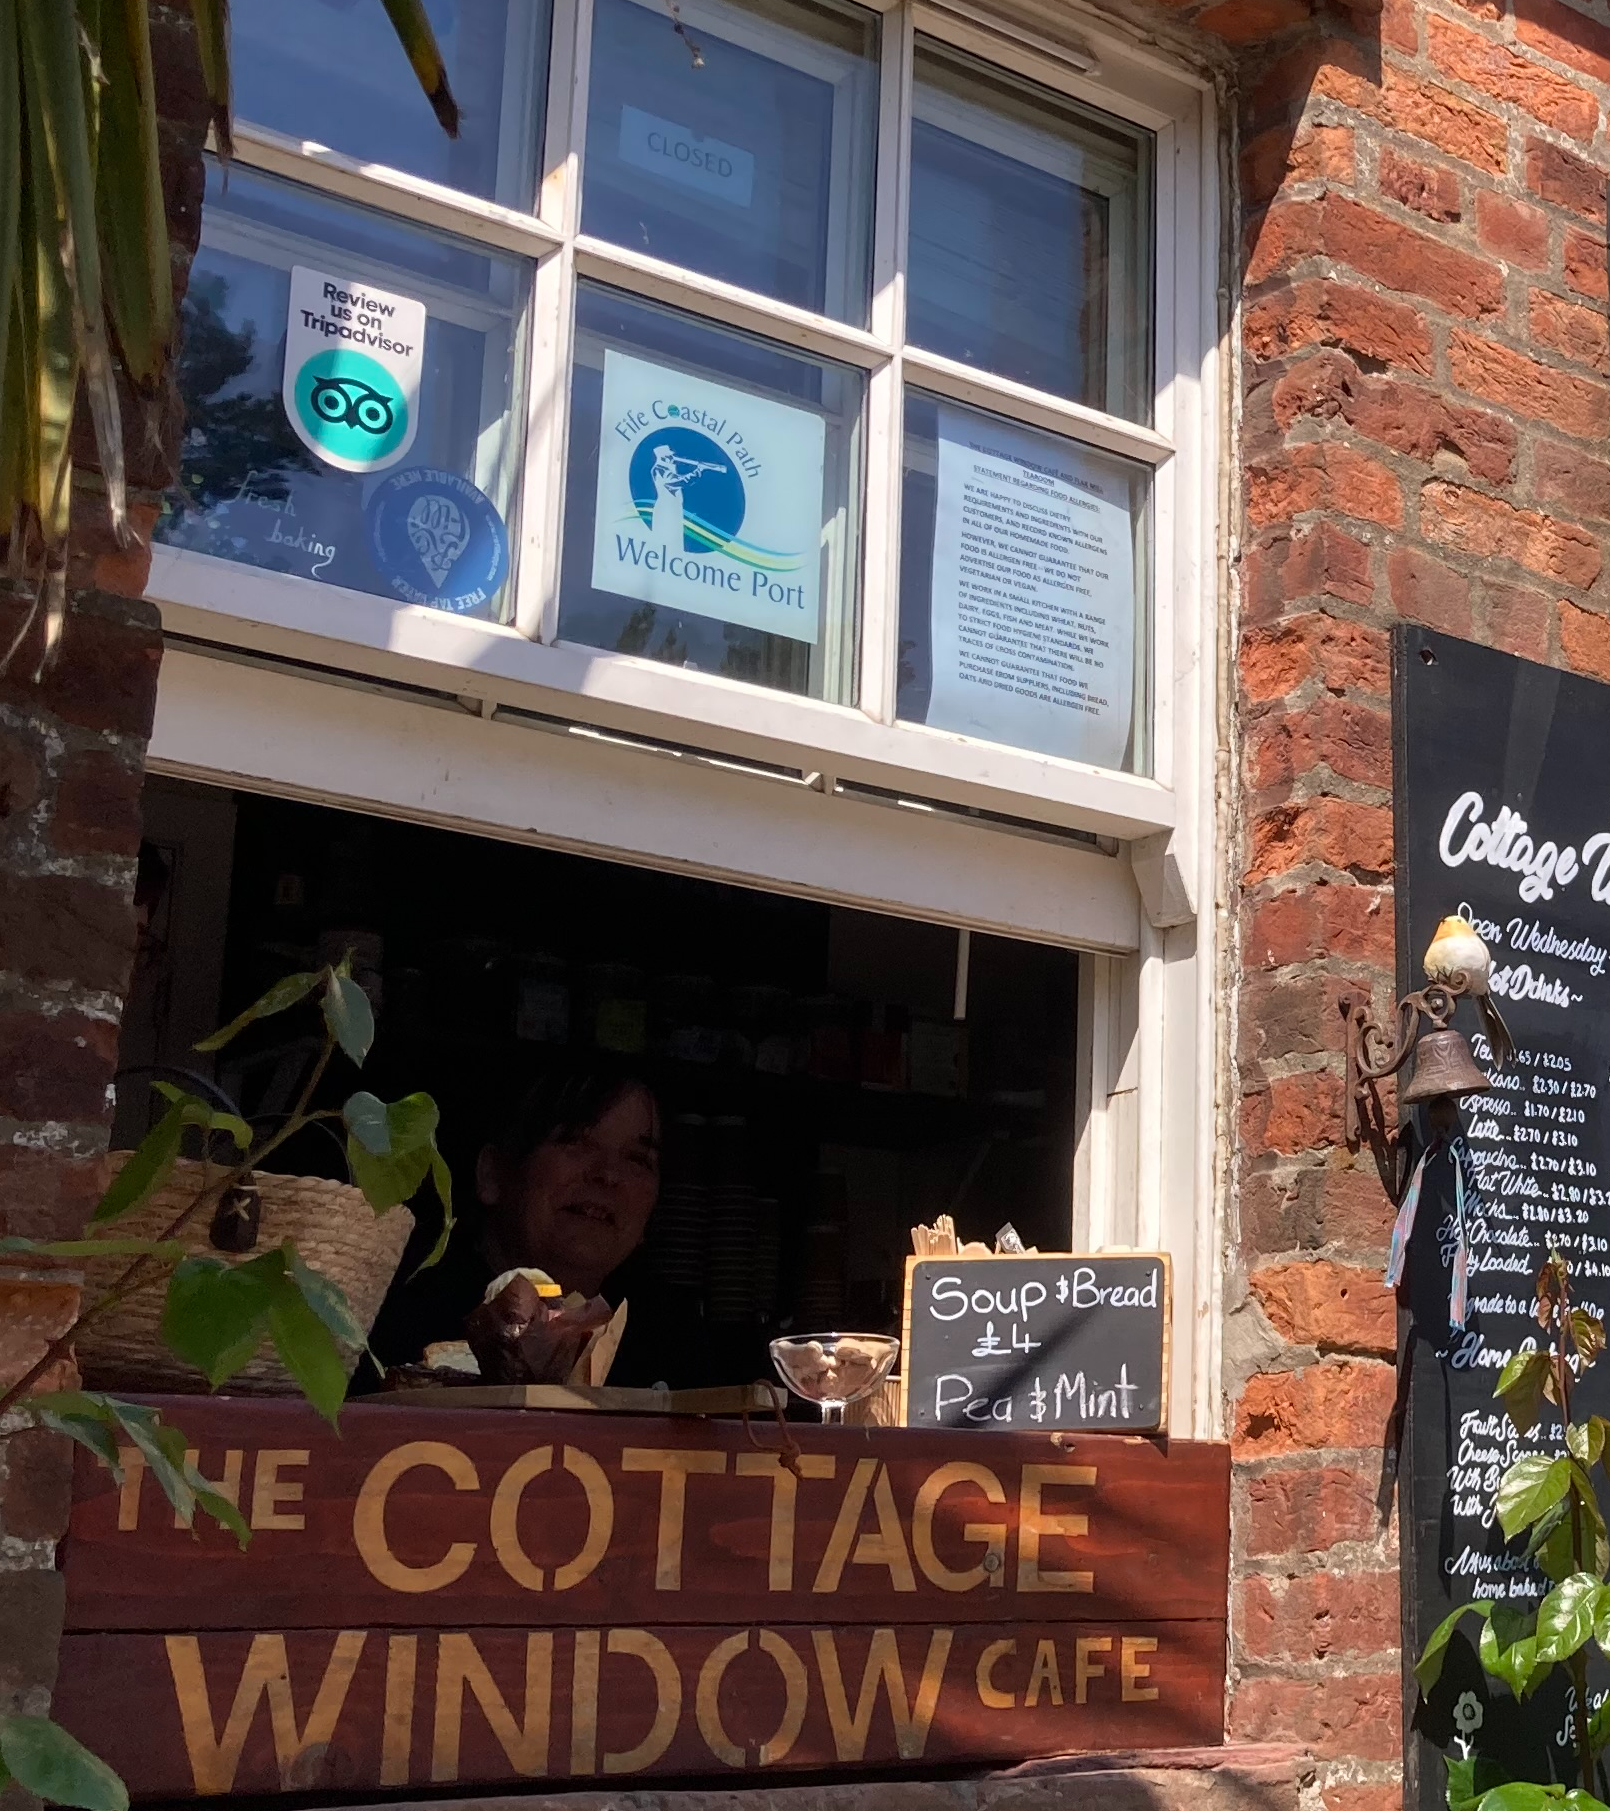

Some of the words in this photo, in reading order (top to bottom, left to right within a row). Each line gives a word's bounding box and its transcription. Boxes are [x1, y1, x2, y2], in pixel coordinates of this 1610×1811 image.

[647, 131, 733, 178] CLOSED
[322, 281, 396, 318] Review
[330, 303, 353, 322] us
[356, 313, 382, 331] on
[300, 309, 414, 357] Tripadvisor
[614, 408, 650, 442] Fife
[651, 400, 727, 437] Coastal
[725, 431, 763, 479] Path
[220, 470, 297, 517] fresh
[263, 517, 337, 580] baking
[615, 533, 742, 592] Welcome
[752, 570, 806, 610] Port
[1439, 791, 1579, 904] Cottage
[1506, 917, 1608, 977] Wednesday
[1467, 1164, 1496, 1193] Flat
[1478, 1246, 1534, 1276] Loaded
[930, 1275, 1048, 1322] Soup
[1071, 1266, 1159, 1310] Bread
[971, 1321, 1042, 1358] £4
[935, 1373, 1012, 1423] Pea
[1054, 1362, 1139, 1421] Mint
[1446, 1465, 1481, 1493] With
[98, 1445, 311, 1532] THE
[352, 1439, 1098, 1594] COTTAGE
[1450, 1493, 1484, 1517] With
[1472, 1576, 1507, 1600] home
[163, 1628, 955, 1796] WINDOW
[975, 1636, 1159, 1710] CAFE
